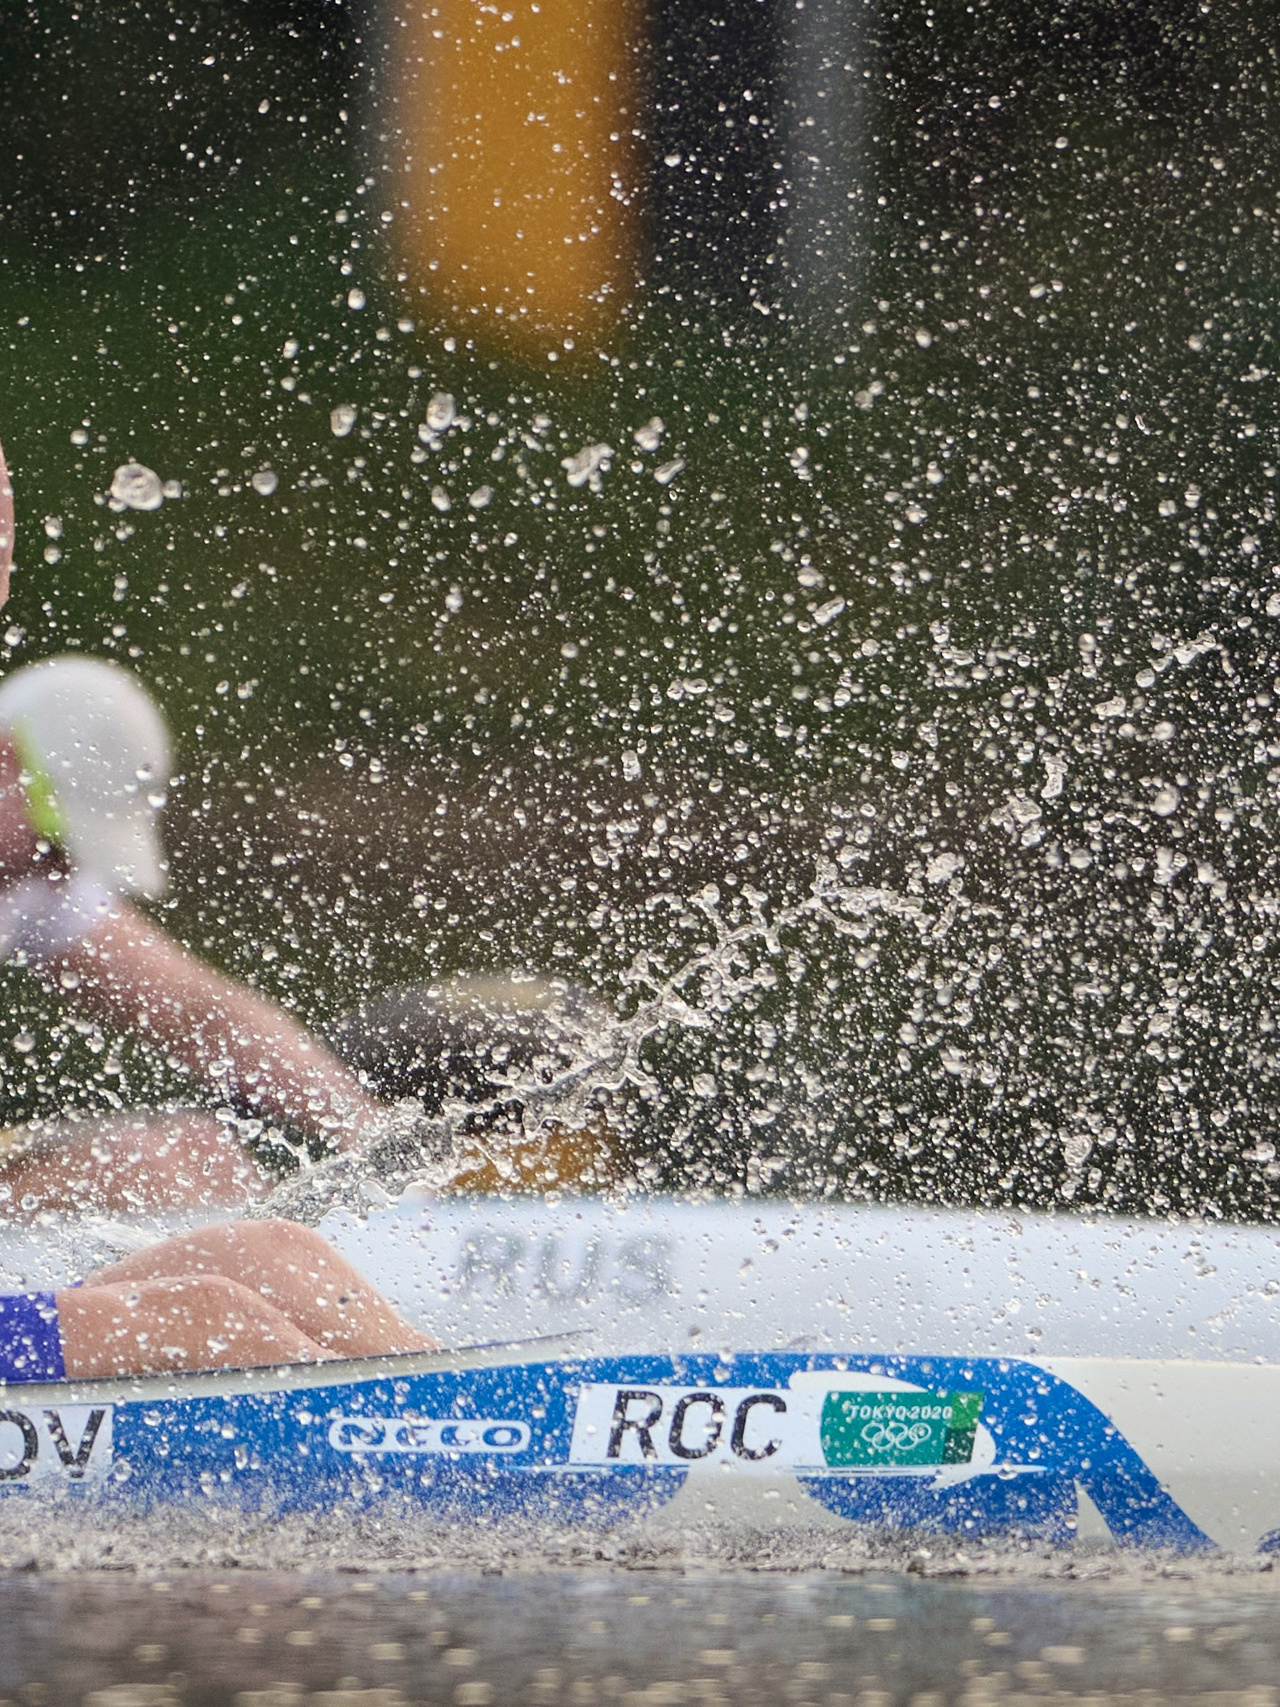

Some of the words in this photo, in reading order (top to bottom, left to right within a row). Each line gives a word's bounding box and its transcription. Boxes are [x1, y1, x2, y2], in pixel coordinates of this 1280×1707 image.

[458, 1230, 675, 1303] RUS
[607, 1389, 787, 1462] ROC
[849, 1404, 906, 1420] TOKYO
[907, 1404, 954, 1419] 2020
